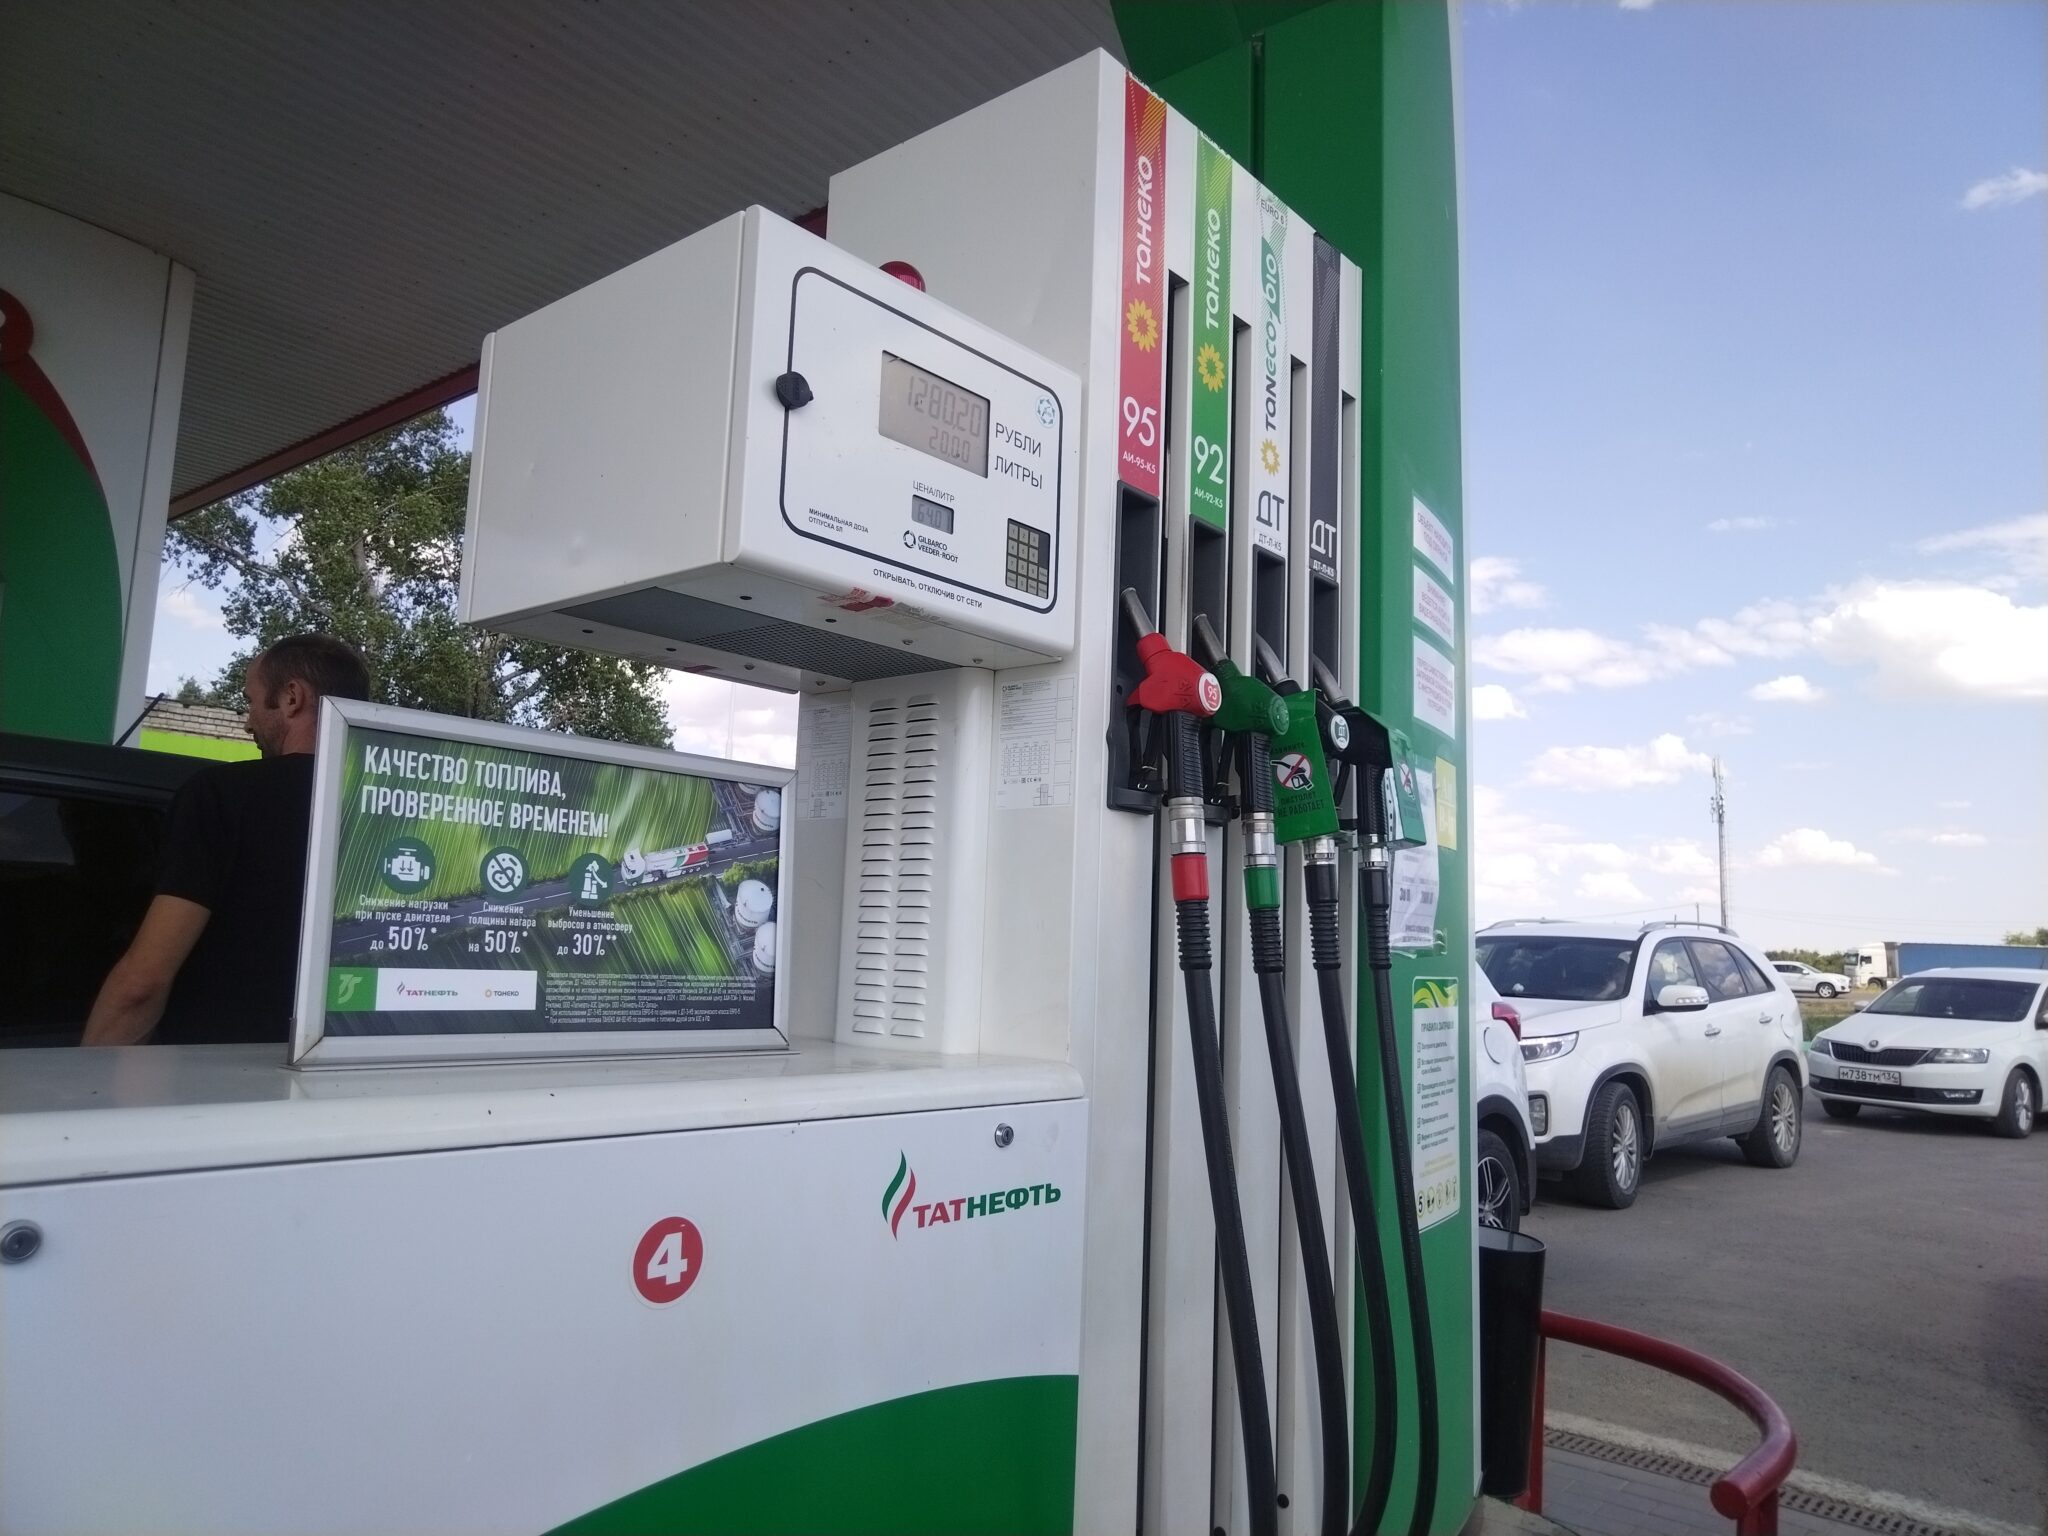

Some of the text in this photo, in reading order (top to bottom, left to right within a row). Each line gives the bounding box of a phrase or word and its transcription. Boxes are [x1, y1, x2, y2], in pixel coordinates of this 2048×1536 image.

[1260, 200, 1285, 225] EURO 6
[1123, 396, 1157, 447] 95
[995, 423, 1042, 457] РУБЛИ
[1122, 450, 1156, 475] АИ-95-К5
[1194, 435, 1224, 485] 92
[994, 455, 1042, 490] ЛИТРЫ
[912, 480, 955, 503] ЦЕНА/ЛИТР
[1194, 487, 1223, 509] АИ-92-К5
[809, 508, 869, 534] МИНИМАЛЬНАЯ ДОЗА
[1256, 490, 1285, 531] ДТ
[808, 516, 835, 531] ОТПУСКА
[918, 535, 948, 551] GILBARCO
[1310, 519, 1336, 558] ДТ
[918, 543, 958, 563] VEEDER-ROOT
[873, 568, 983, 609] ОТКРЫВАТЬ, ОТКЛЮЧИВ ОТ СЕТИ
[1207, 686, 1217, 700] 95
[364, 744, 567, 801] КАЧЕСТВО ТОПЛИВА,
[361, 786, 609, 838] ПРОВЕРЕННОЕ ВРЕМЕНЕМ!
[360, 894, 448, 912] Снижение нагрузки
[483, 901, 524, 914] Снижение
[569, 906, 615, 919] Уменьшение
[355, 911, 451, 923] при пуске двигателя
[468, 916, 536, 929] толщины нагара
[547, 919, 585, 931] выбросов
[593, 921, 633, 933] атмосферу
[369, 940, 384, 951] до
[468, 942, 479, 953] на
[557, 946, 568, 956] до
[405, 988, 459, 997] ТАТНЕФТЬ
[912, 1182, 1062, 1229] ТАТНЕФТЬ
[646, 1231, 688, 1286] 4
